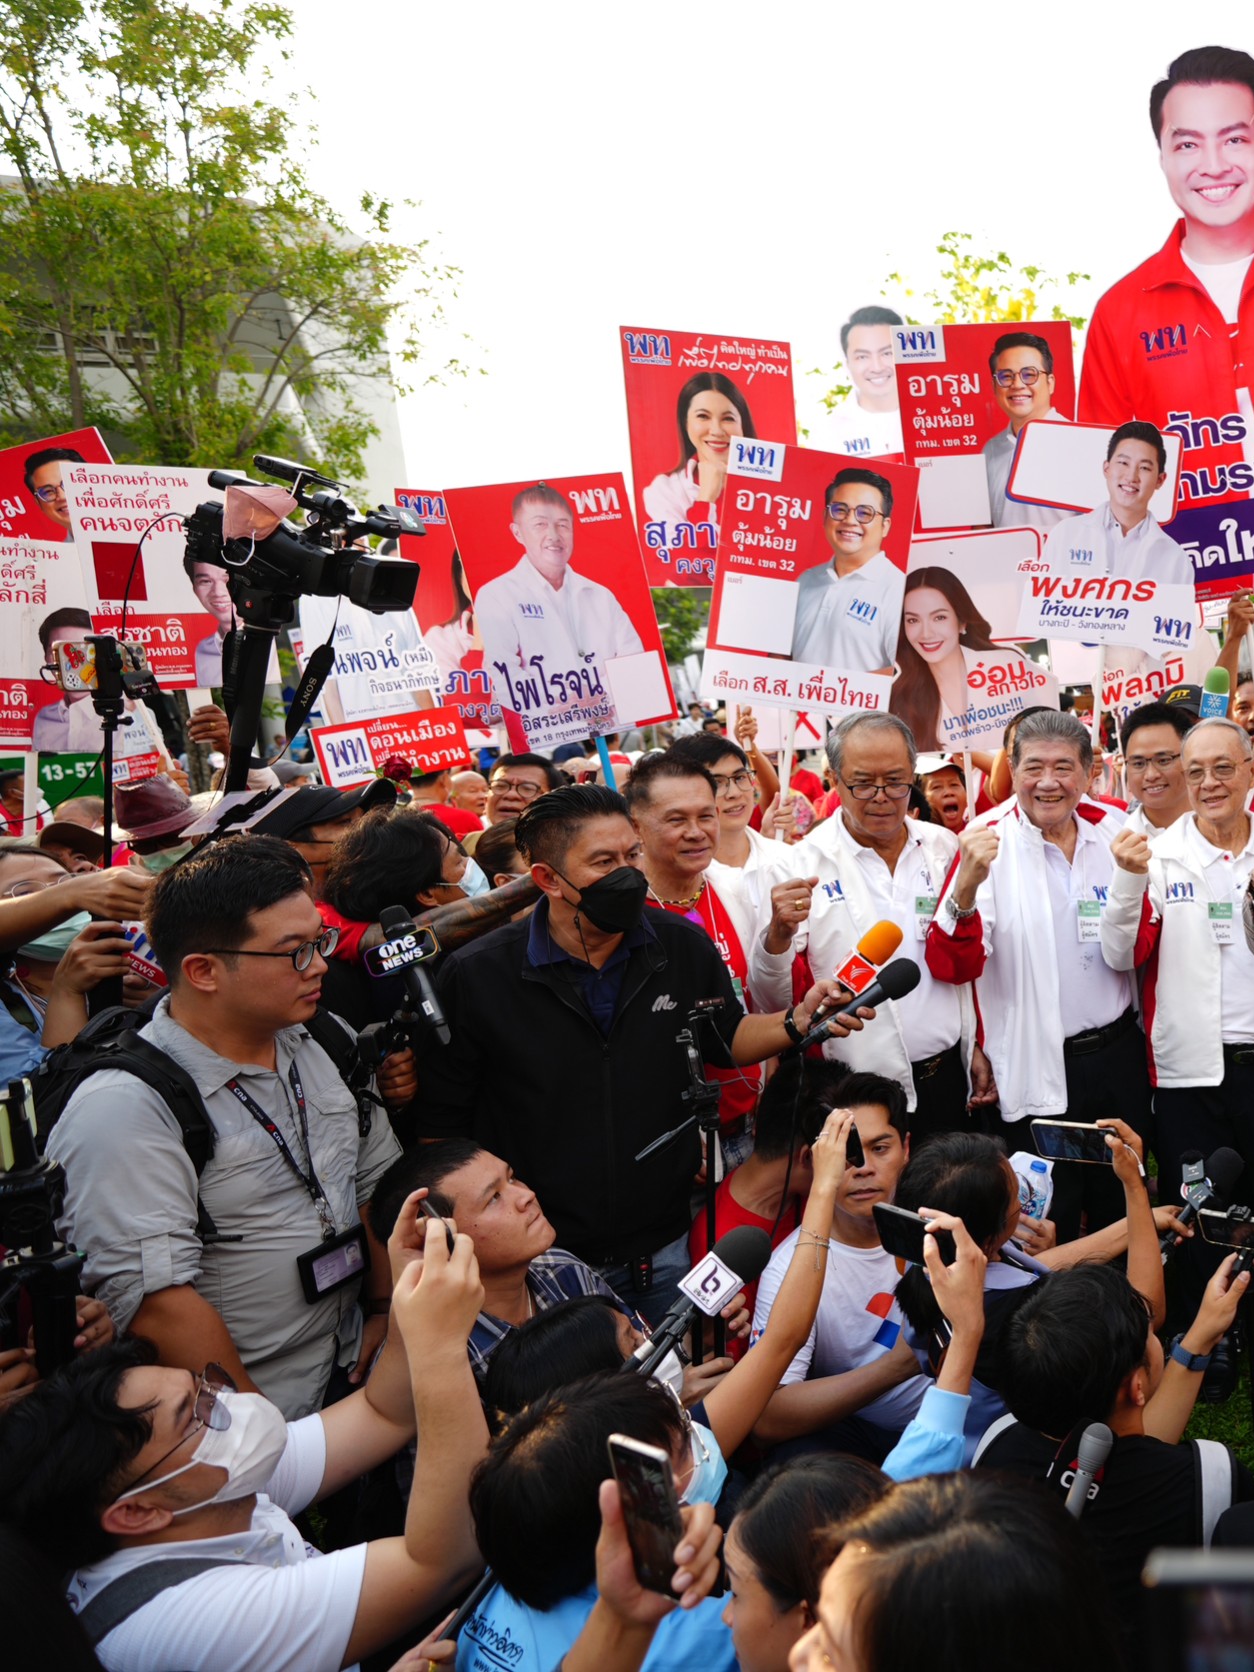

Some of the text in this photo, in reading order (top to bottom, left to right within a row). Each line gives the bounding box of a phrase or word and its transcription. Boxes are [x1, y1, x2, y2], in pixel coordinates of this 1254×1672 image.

[624, 333, 671, 356] พท
[721, 342, 788, 360] คิดใหญ่ ทำเป็น
[897, 330, 935, 350] พท
[1140, 324, 1187, 353] พท
[907, 372, 981, 408] อารุม
[913, 407, 975, 436] ตุ้มน้อย
[915, 435, 978, 448] กทม. เขต 32
[736, 442, 775, 468] พท
[70, 468, 188, 487] เลือกคนทำงาน
[75, 488, 171, 510] เพื่อศักดิ์ศรี
[569, 486, 621, 514] พท
[735, 488, 812, 530] อารุม
[80, 512, 183, 540] คนจตุจัก
[579, 512, 622, 524] พรรคเพื่อไทย
[646, 520, 716, 562] สุภา
[732, 522, 797, 552] ตุ้มน้อย
[729, 554, 795, 572] กทม. เขต 32
[1017, 559, 1050, 573] เลือก
[1031, 576, 1156, 601] พงศกร
[849, 597, 877, 622] พท
[1040, 599, 1129, 620] ให้ชนะขาด
[1038, 617, 1126, 631] บางกะปิ วังทองหลาง
[1154, 615, 1192, 640] พท
[301, 677, 317, 707] SONY
[493, 651, 603, 713] ไพโรจน์
[712, 670, 879, 711] เลือก ส.ส. เพื่อไทย
[986, 672, 1046, 697] สกาวใจ
[521, 695, 609, 732] อิสระเสรีพงษ์
[943, 696, 1024, 731] มาเพื่อชนะ!!!
[370, 720, 457, 750] ดอนเมือง
[326, 737, 368, 768] พท
[42, 763, 96, 781] 13-57
[378, 934, 417, 959] one
[383, 947, 424, 971] NEWS
[128, 955, 156, 978] EWS
[652, 995, 677, 1012] Me
[1060, 1470, 1099, 1500] ca
